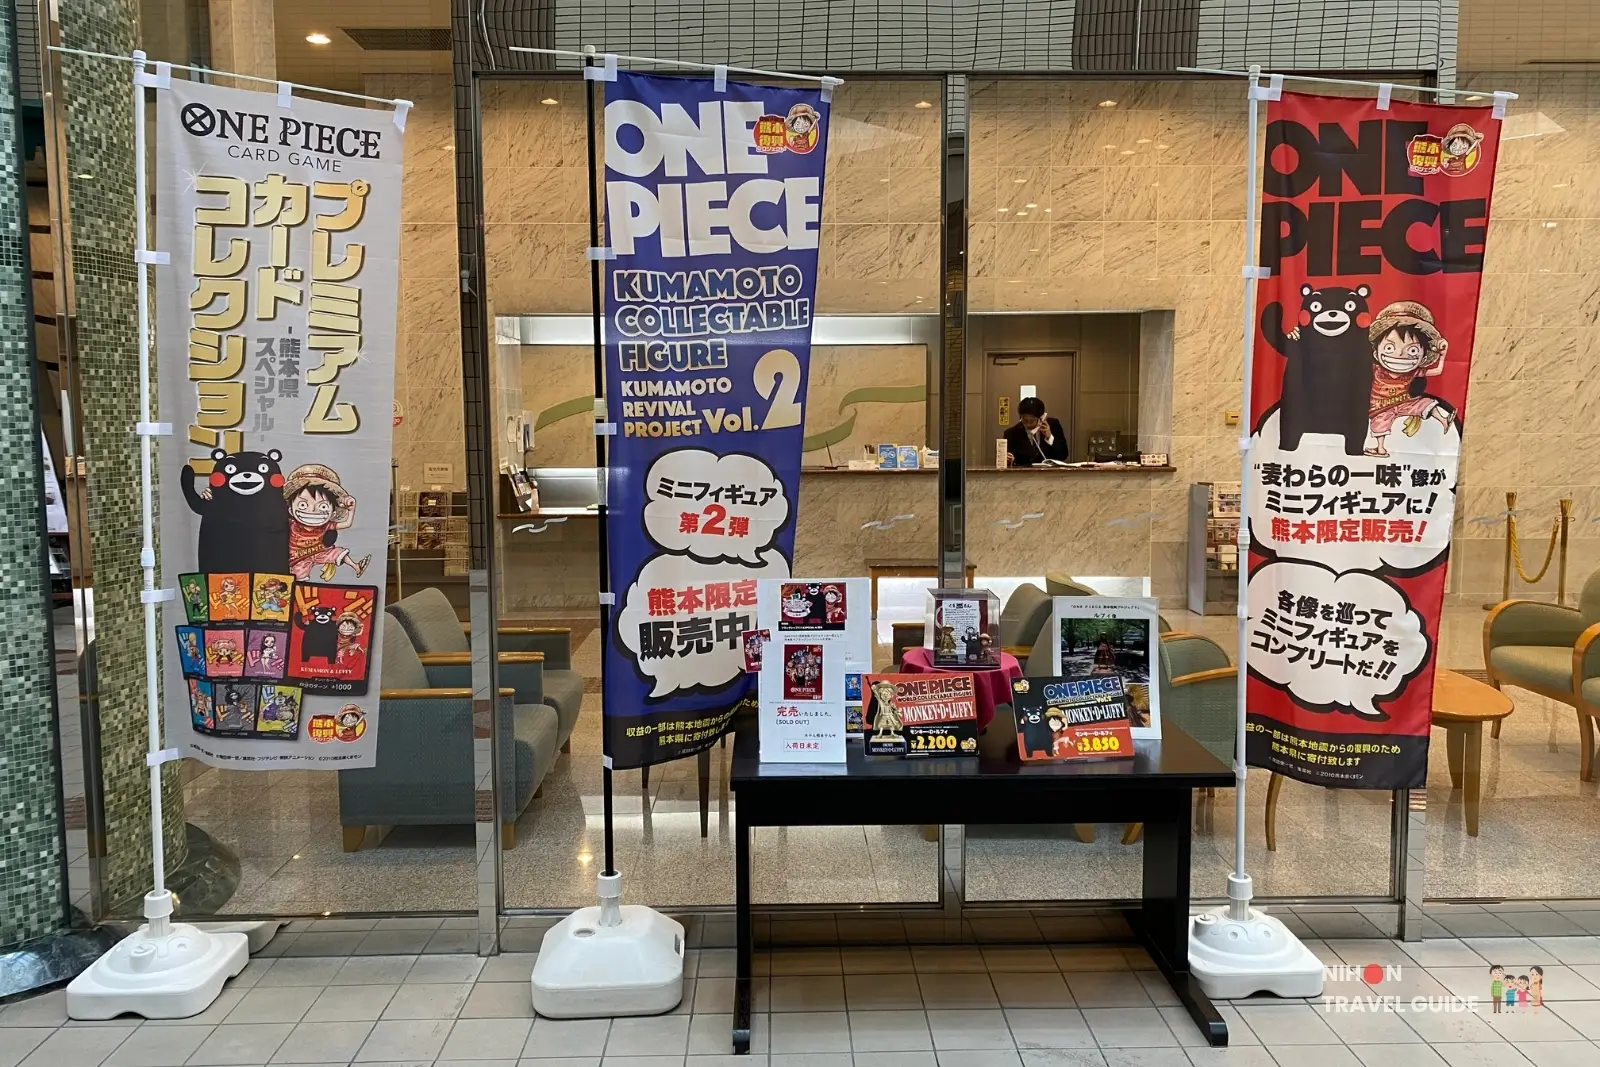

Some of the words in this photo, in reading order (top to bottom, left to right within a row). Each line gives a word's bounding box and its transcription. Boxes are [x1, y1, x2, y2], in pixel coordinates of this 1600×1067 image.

[181, 103, 269, 144] ONE
[279, 117, 381, 159] PIECE
[604, 100, 768, 177] ONE
[228, 145, 279, 162] CARD
[288, 153, 341, 173] GAME
[1263, 119, 1428, 198] ONE
[606, 177, 820, 257] PIECE
[253, 174, 309, 320] カード
[1260, 198, 1486, 276] PIECE
[613, 265, 803, 302] KUMAMOTO
[188, 174, 250, 476] コレクション
[303, 180, 371, 434] プレミアム
[615, 298, 810, 337] COLLECTABLE
[619, 338, 728, 372] FIGURE
[621, 377, 732, 397] KUMAMOTO
[702, 406, 759, 434] Vol.
[753, 349, 802, 430] 2
[623, 400, 696, 417] REVIVAL
[624, 420, 702, 437] PROJECT
[656, 477, 778, 506] ミニフィギュア
[1265, 490, 1437, 516] ミニフィギュアに!
[678, 504, 750, 538] 第2弾
[1270, 518, 1429, 544] 熊本限定販売!
[647, 580, 758, 617] 熊本限定
[1277, 590, 1393, 630] 各像を巡って
[638, 612, 758, 662] 販売中
[1261, 607, 1399, 656] ミニフィギュアを
[1251, 630, 1397, 680] コンプリートだ!!
[895, 680, 928, 697] ONE
[929, 676, 971, 694] PIECE
[917, 692, 952, 701] COLLECTABLE
[1043, 681, 1077, 700] ONE
[1078, 677, 1122, 696] PIECE
[776, 706, 832, 718] 完売いたしました。
[911, 735, 957, 750] ¥2,200
[1271, 742, 1361, 767] 熊本県に寄付致します
